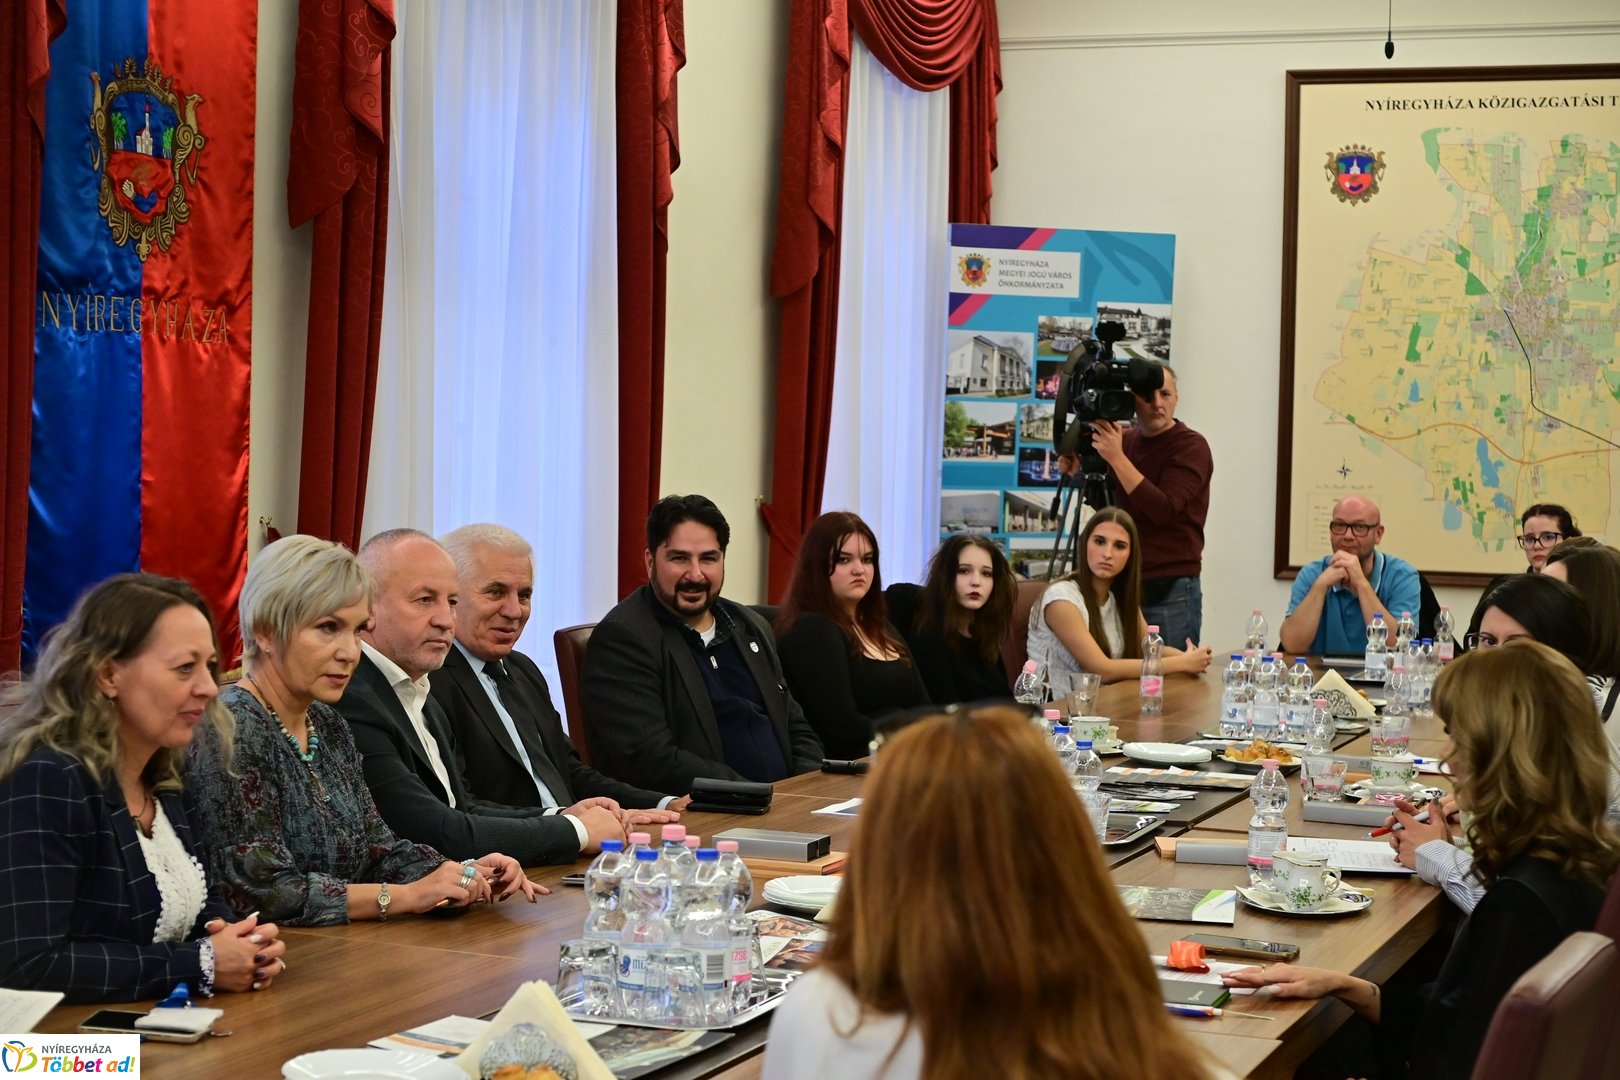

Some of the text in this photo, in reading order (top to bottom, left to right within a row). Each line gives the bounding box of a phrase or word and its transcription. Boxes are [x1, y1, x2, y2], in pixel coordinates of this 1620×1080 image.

[1365, 96, 1474, 111] NYÍREGYHÁZA
[1478, 93, 1605, 110] KÖZIGAZGATÁSI
[999, 258, 1049, 268] NYÍREGYHÁZA
[998, 269, 1072, 280] MEGYEI JOGÚ VÁROS
[998, 279, 1064, 289] ÖNKORMÁNYZATA
